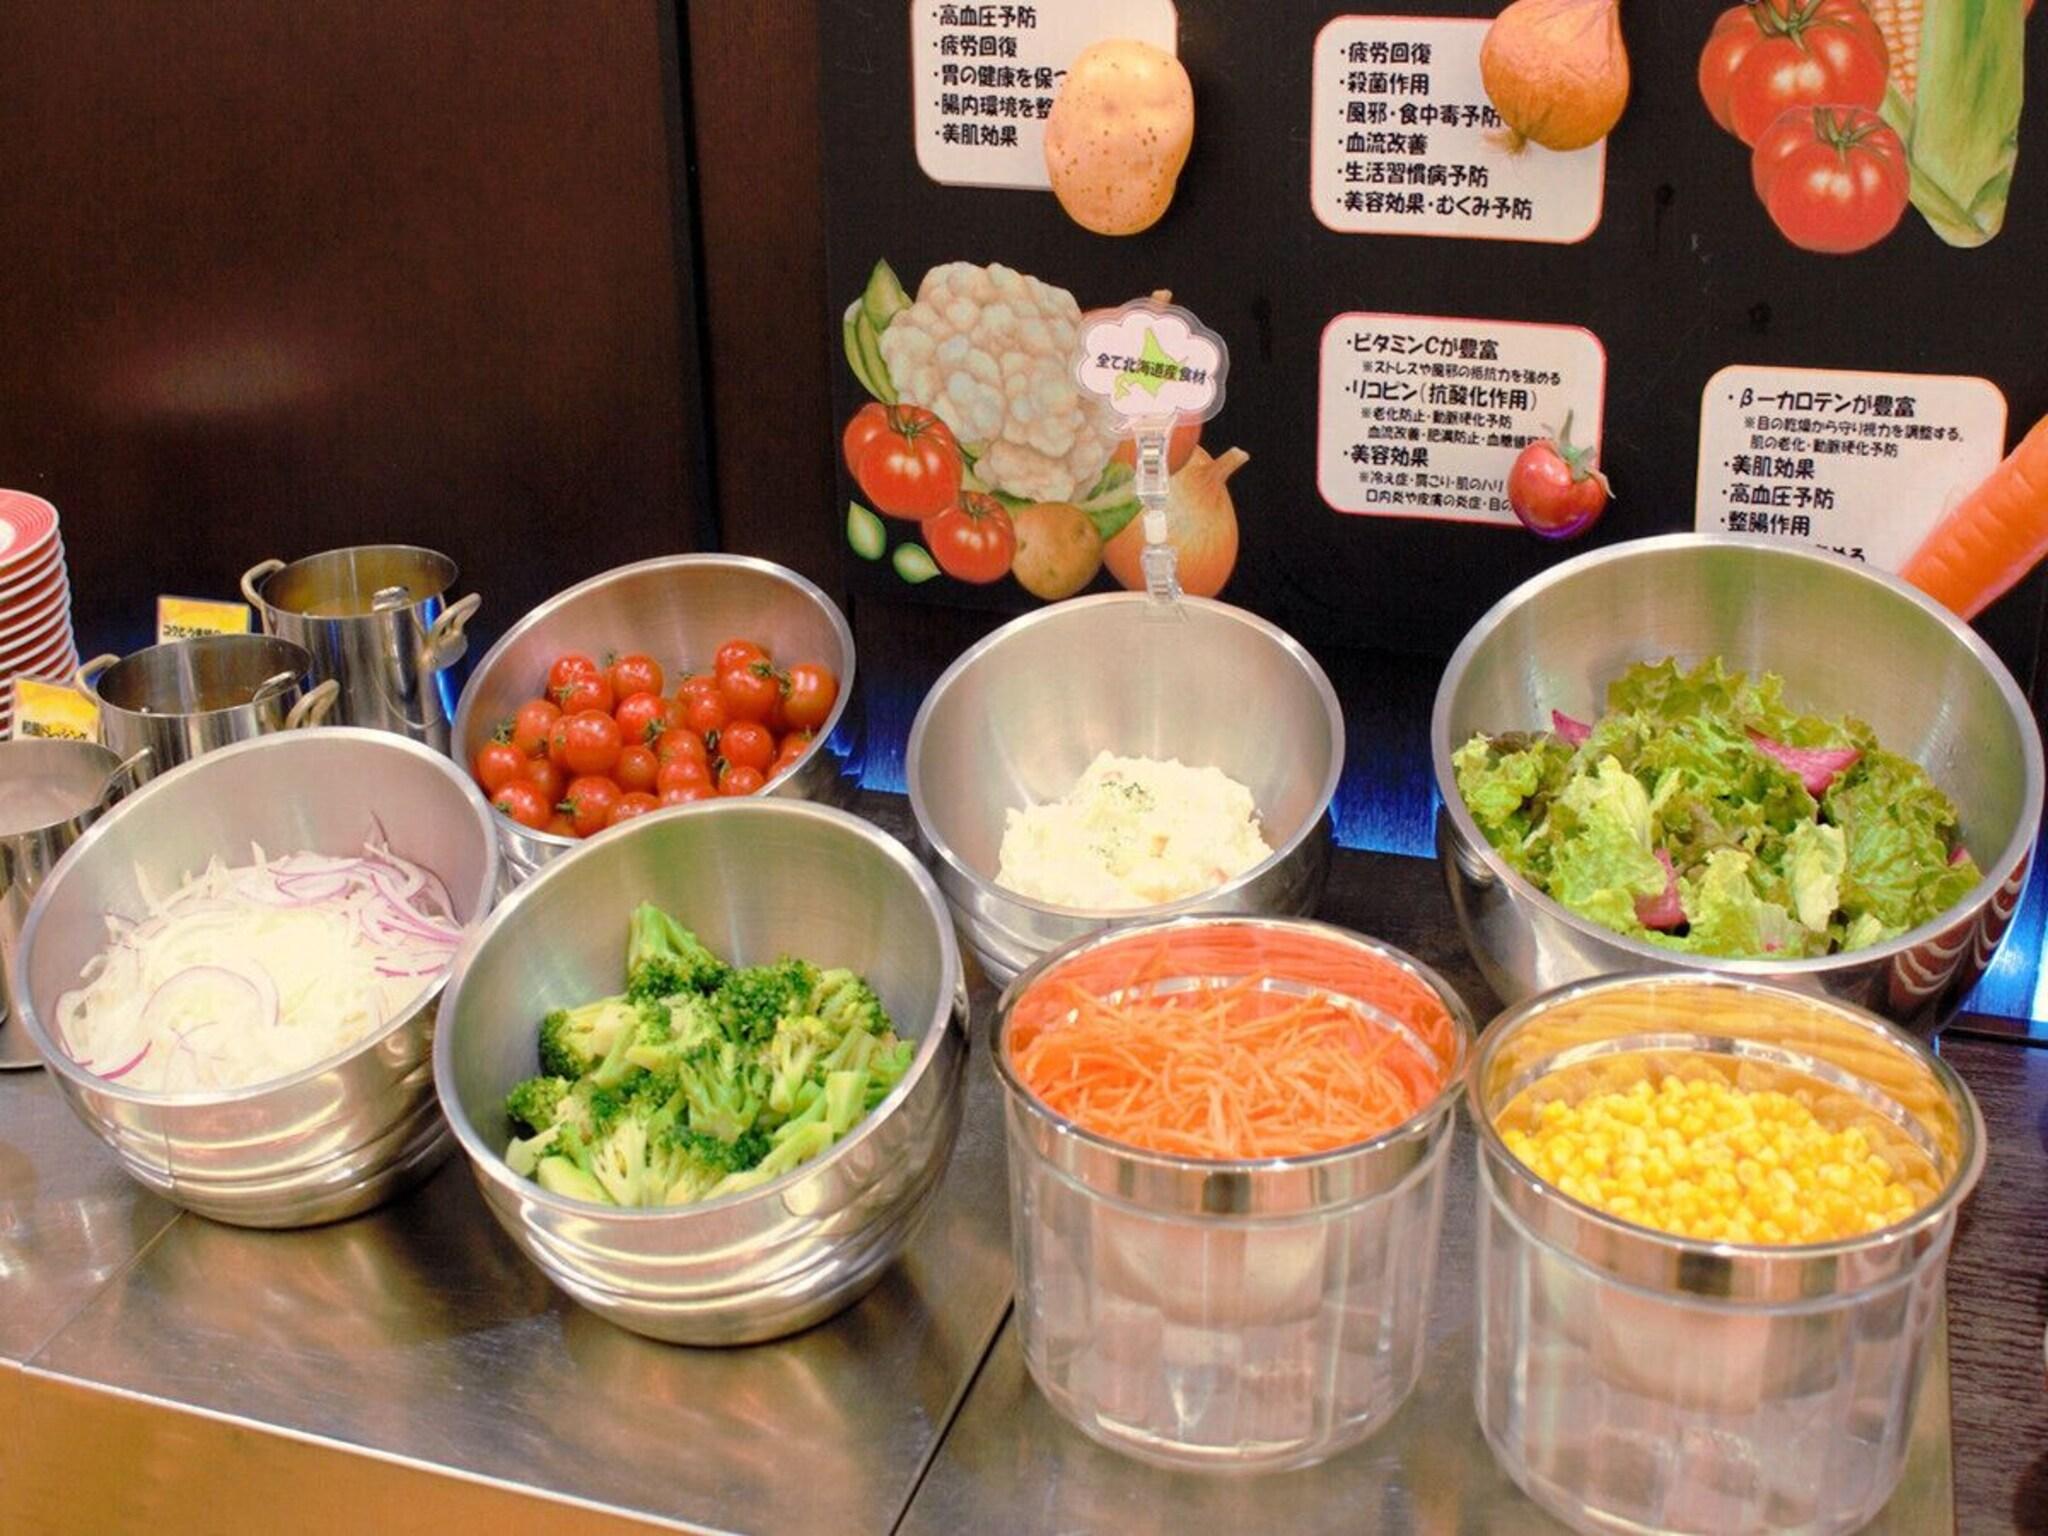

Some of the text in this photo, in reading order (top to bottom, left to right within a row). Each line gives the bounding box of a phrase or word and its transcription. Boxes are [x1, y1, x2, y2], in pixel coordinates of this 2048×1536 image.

[932, 35, 1018, 58] ・疲労回復
[1340, 42, 1432, 64] ・疲労回復
[1340, 72, 1430, 95] ・殺菌作用
[934, 123, 1018, 147] ・美肌効果
[1338, 133, 1428, 155] ・血流改善
[1096, 352, 1207, 386] 全て北海道産食材
[1343, 444, 1429, 467] ・美容効果
[1724, 455, 1816, 480] ・美肌効果
